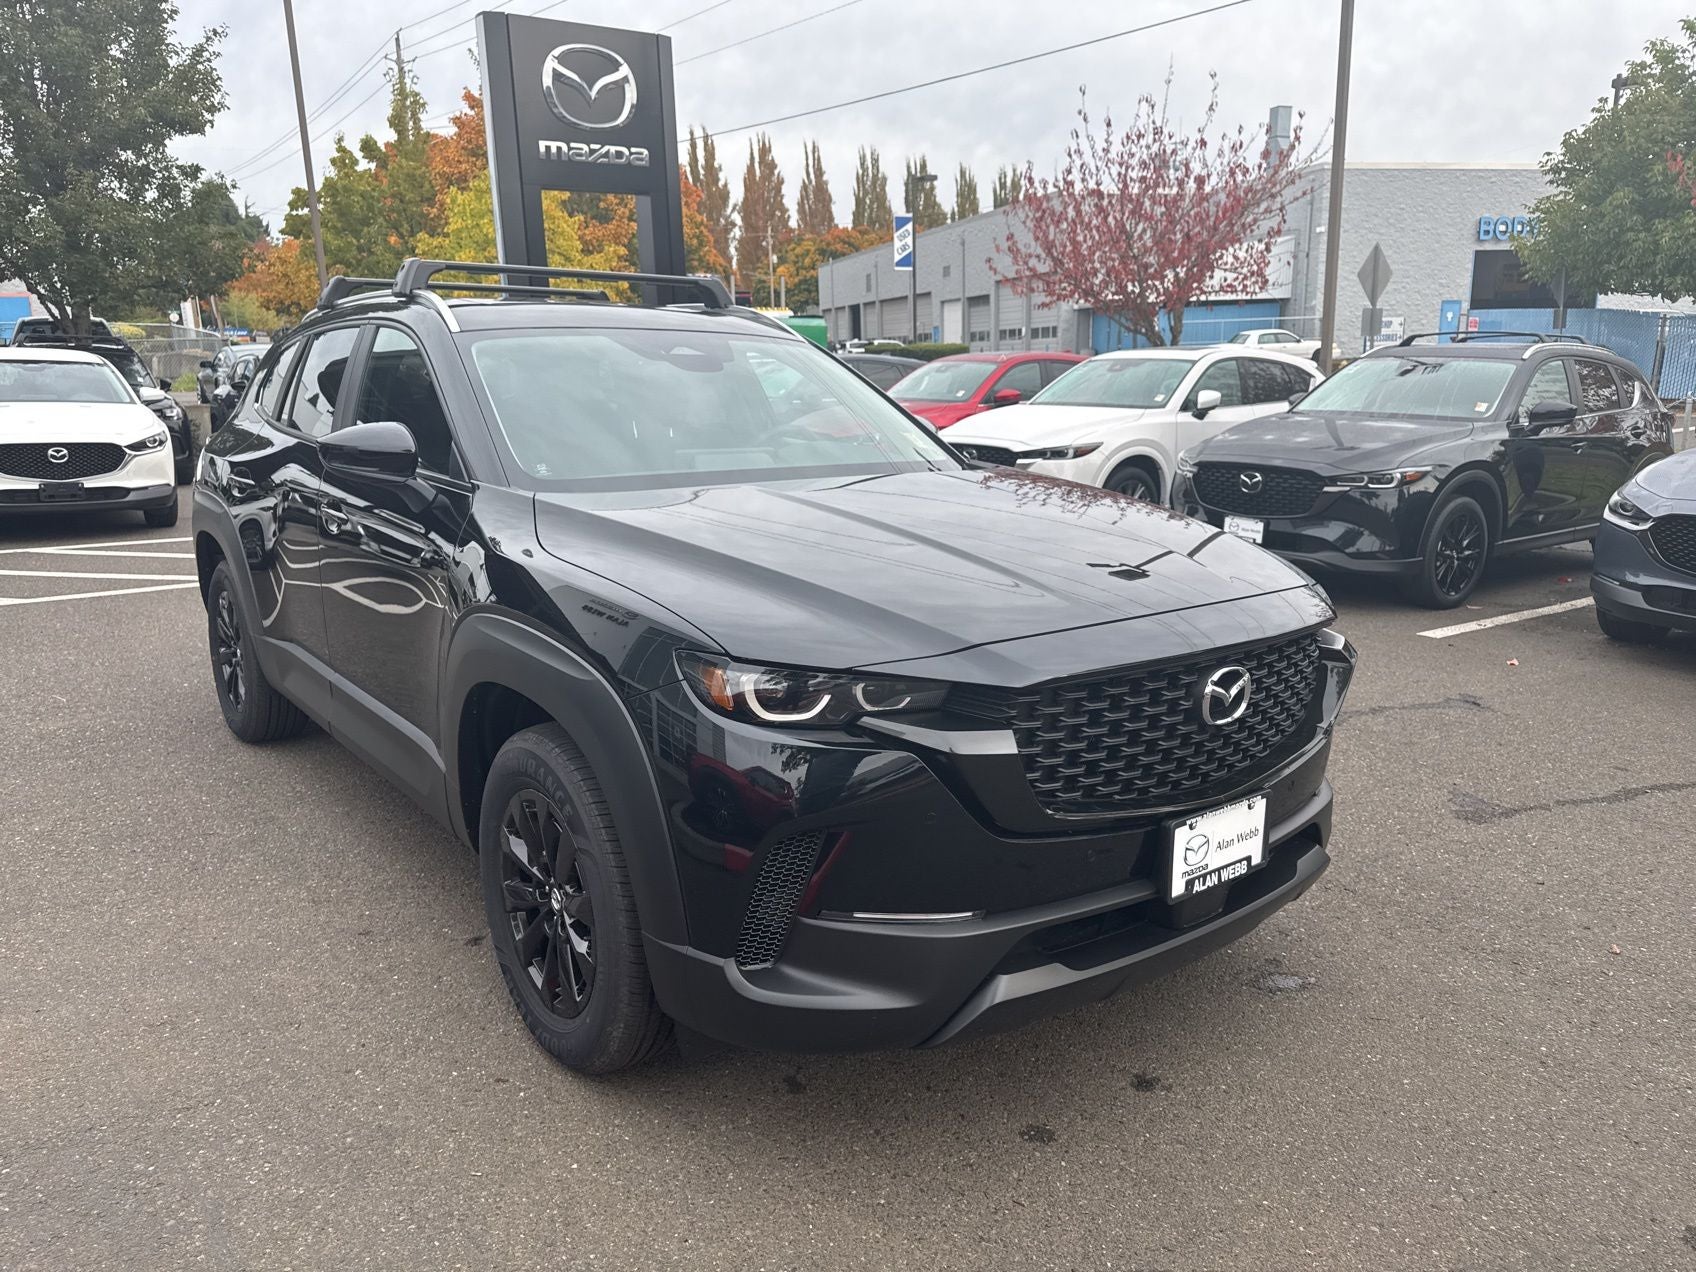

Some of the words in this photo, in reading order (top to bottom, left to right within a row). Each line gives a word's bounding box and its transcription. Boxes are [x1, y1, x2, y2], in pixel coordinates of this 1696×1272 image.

[896, 229, 911, 242] USED
[896, 242, 911, 255] CARS
[1215, 838, 1234, 853] Alan
[1237, 826, 1259, 844] Webb
[1192, 871, 1219, 894] ALAN
[1220, 860, 1248, 882] WEBB
